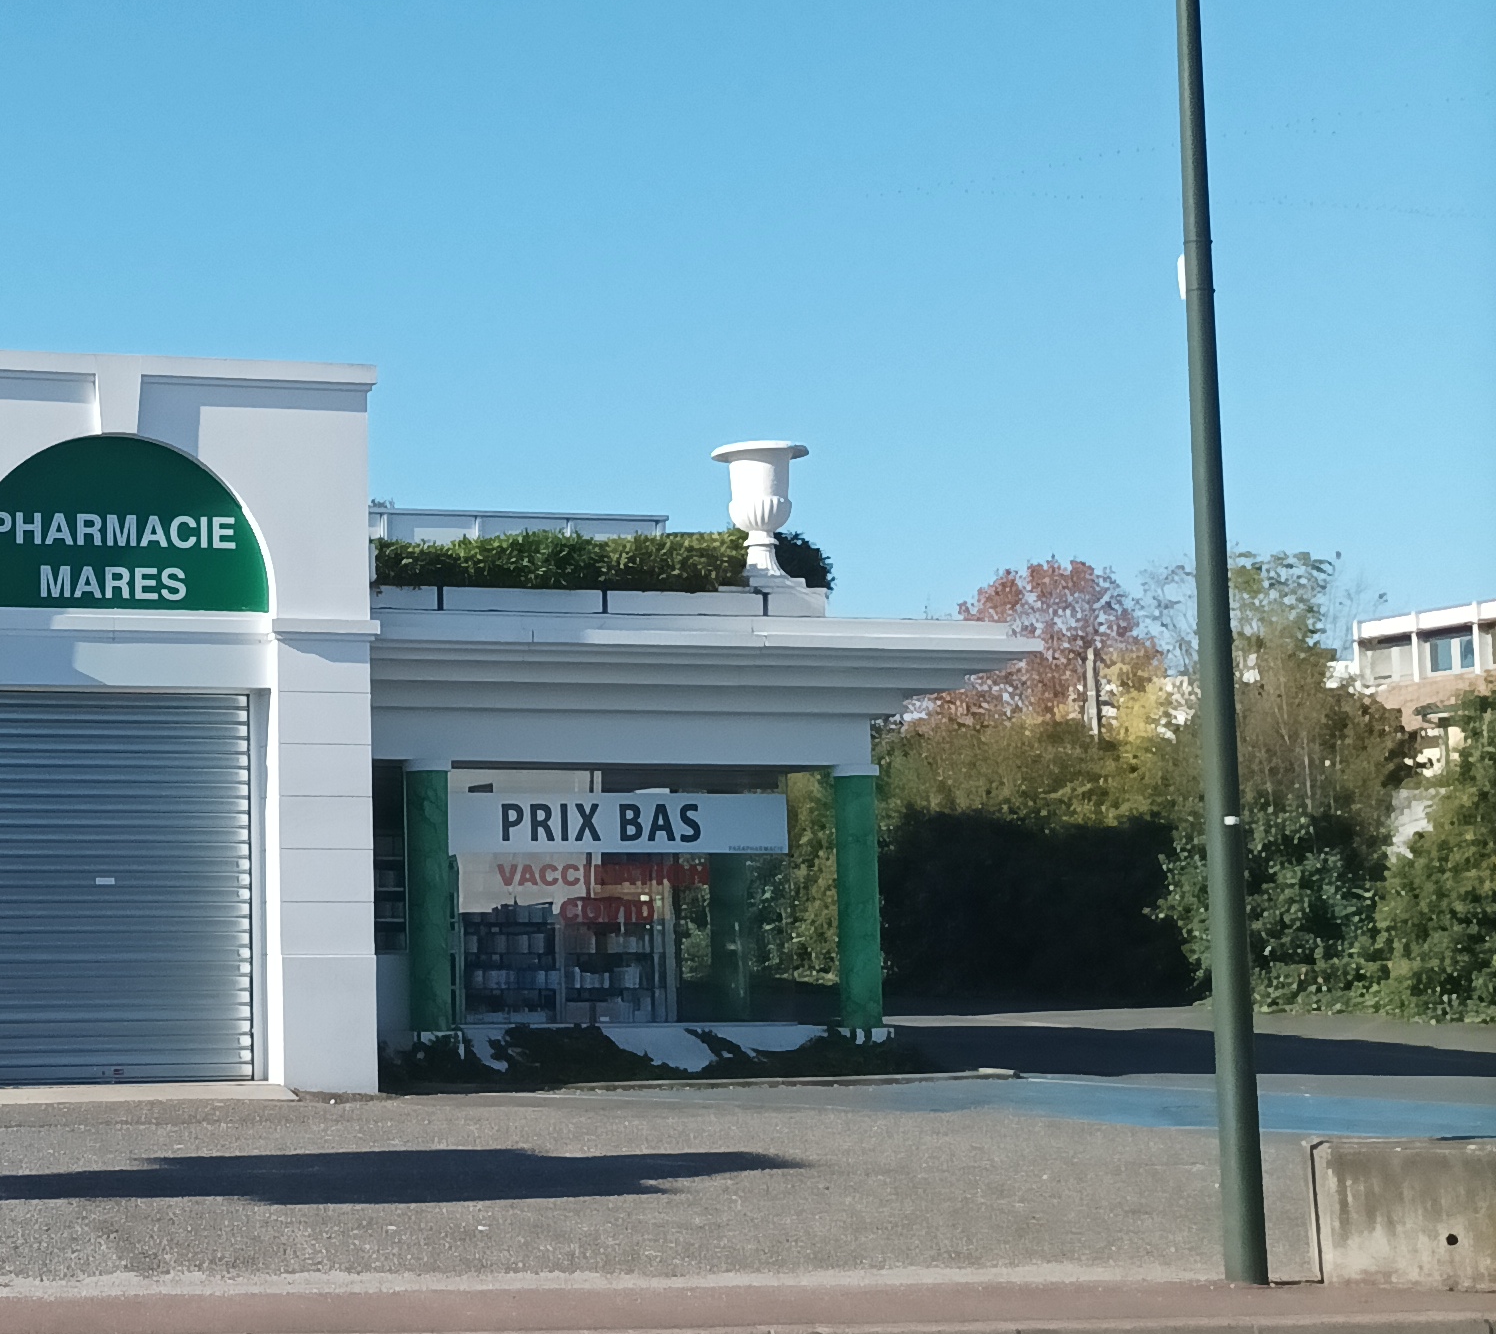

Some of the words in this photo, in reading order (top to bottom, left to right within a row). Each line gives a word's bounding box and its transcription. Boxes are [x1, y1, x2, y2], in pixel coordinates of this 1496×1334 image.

[39, 565, 187, 601] MARES
[500, 803, 602, 842] PRIX
[618, 803, 702, 843] BAS
[496, 863, 710, 887] VACCINATION
[559, 899, 655, 924] COVID
